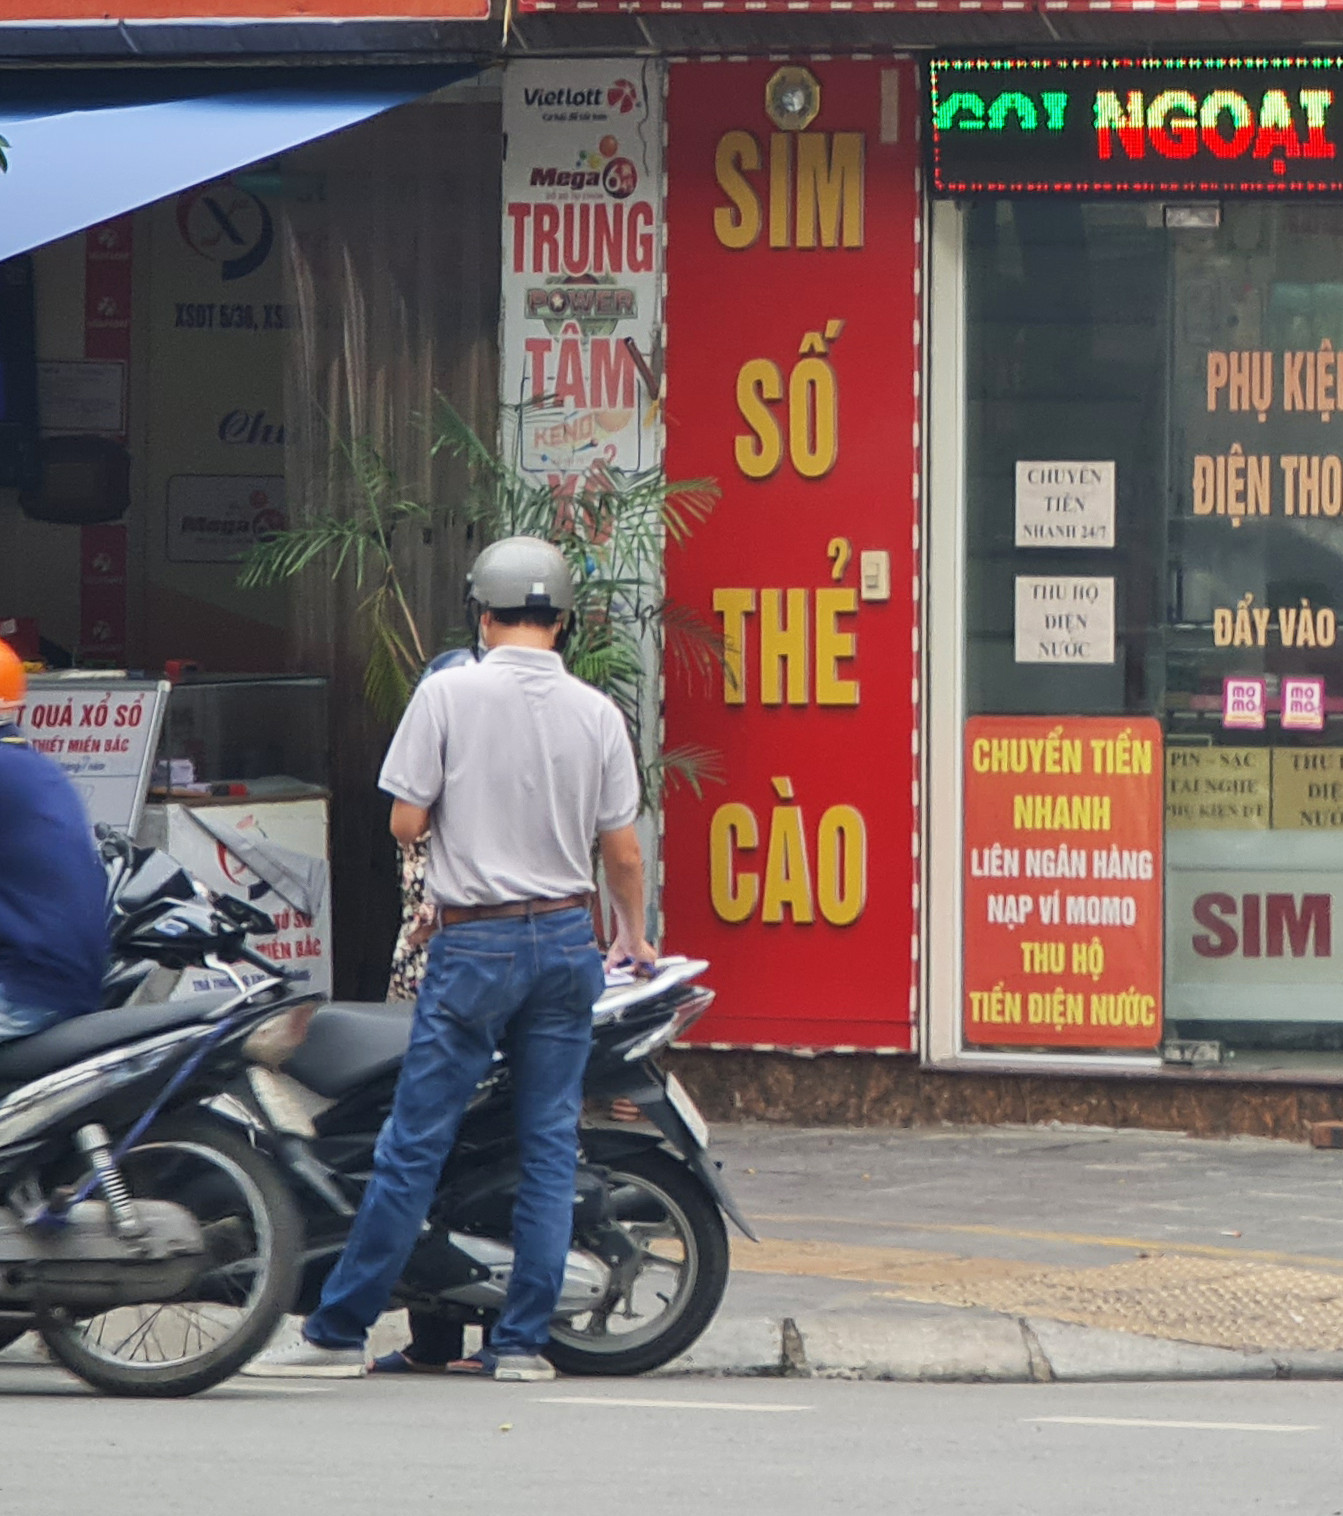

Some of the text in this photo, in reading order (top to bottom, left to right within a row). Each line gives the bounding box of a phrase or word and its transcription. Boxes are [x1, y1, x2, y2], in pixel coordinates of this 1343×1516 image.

[524, 88, 603, 107] Vietlott
[1095, 89, 1335, 175] NGOẠI
[530, 167, 600, 190] Mega
[713, 130, 865, 250] SIM
[507, 201, 654, 275] TRUNG
[527, 288, 635, 314] POWER
[525, 321, 635, 409] TÂM
[1207, 351, 1273, 423] PHỤ
[734, 318, 845, 478] SỐ
[1028, 465, 1102, 484] CHUYỂN
[1193, 442, 1271, 528] ĐIỆN
[1023, 525, 1107, 539] NHANH 24/7
[1031, 584, 1067, 600] THU
[712, 536, 861, 706] THẺ
[1214, 592, 1336, 648] ĐẨY VÀO
[31, 697, 73, 729] QUẢ
[79, 692, 112, 727] XỔ
[972, 726, 1153, 774] CHUYỂN TIỀN
[1013, 795, 1111, 831] NHANH
[709, 775, 867, 926] CÀO
[971, 842, 1153, 880] LIÊN NGÂN HÀNG
[987, 889, 1137, 930] NẠP VÍ MOMO
[1192, 891, 1333, 959] SIM
[1021, 936, 1105, 981] THU HỘ
[969, 981, 1156, 1033] TIỀN ĐIỆN NƯỚC
